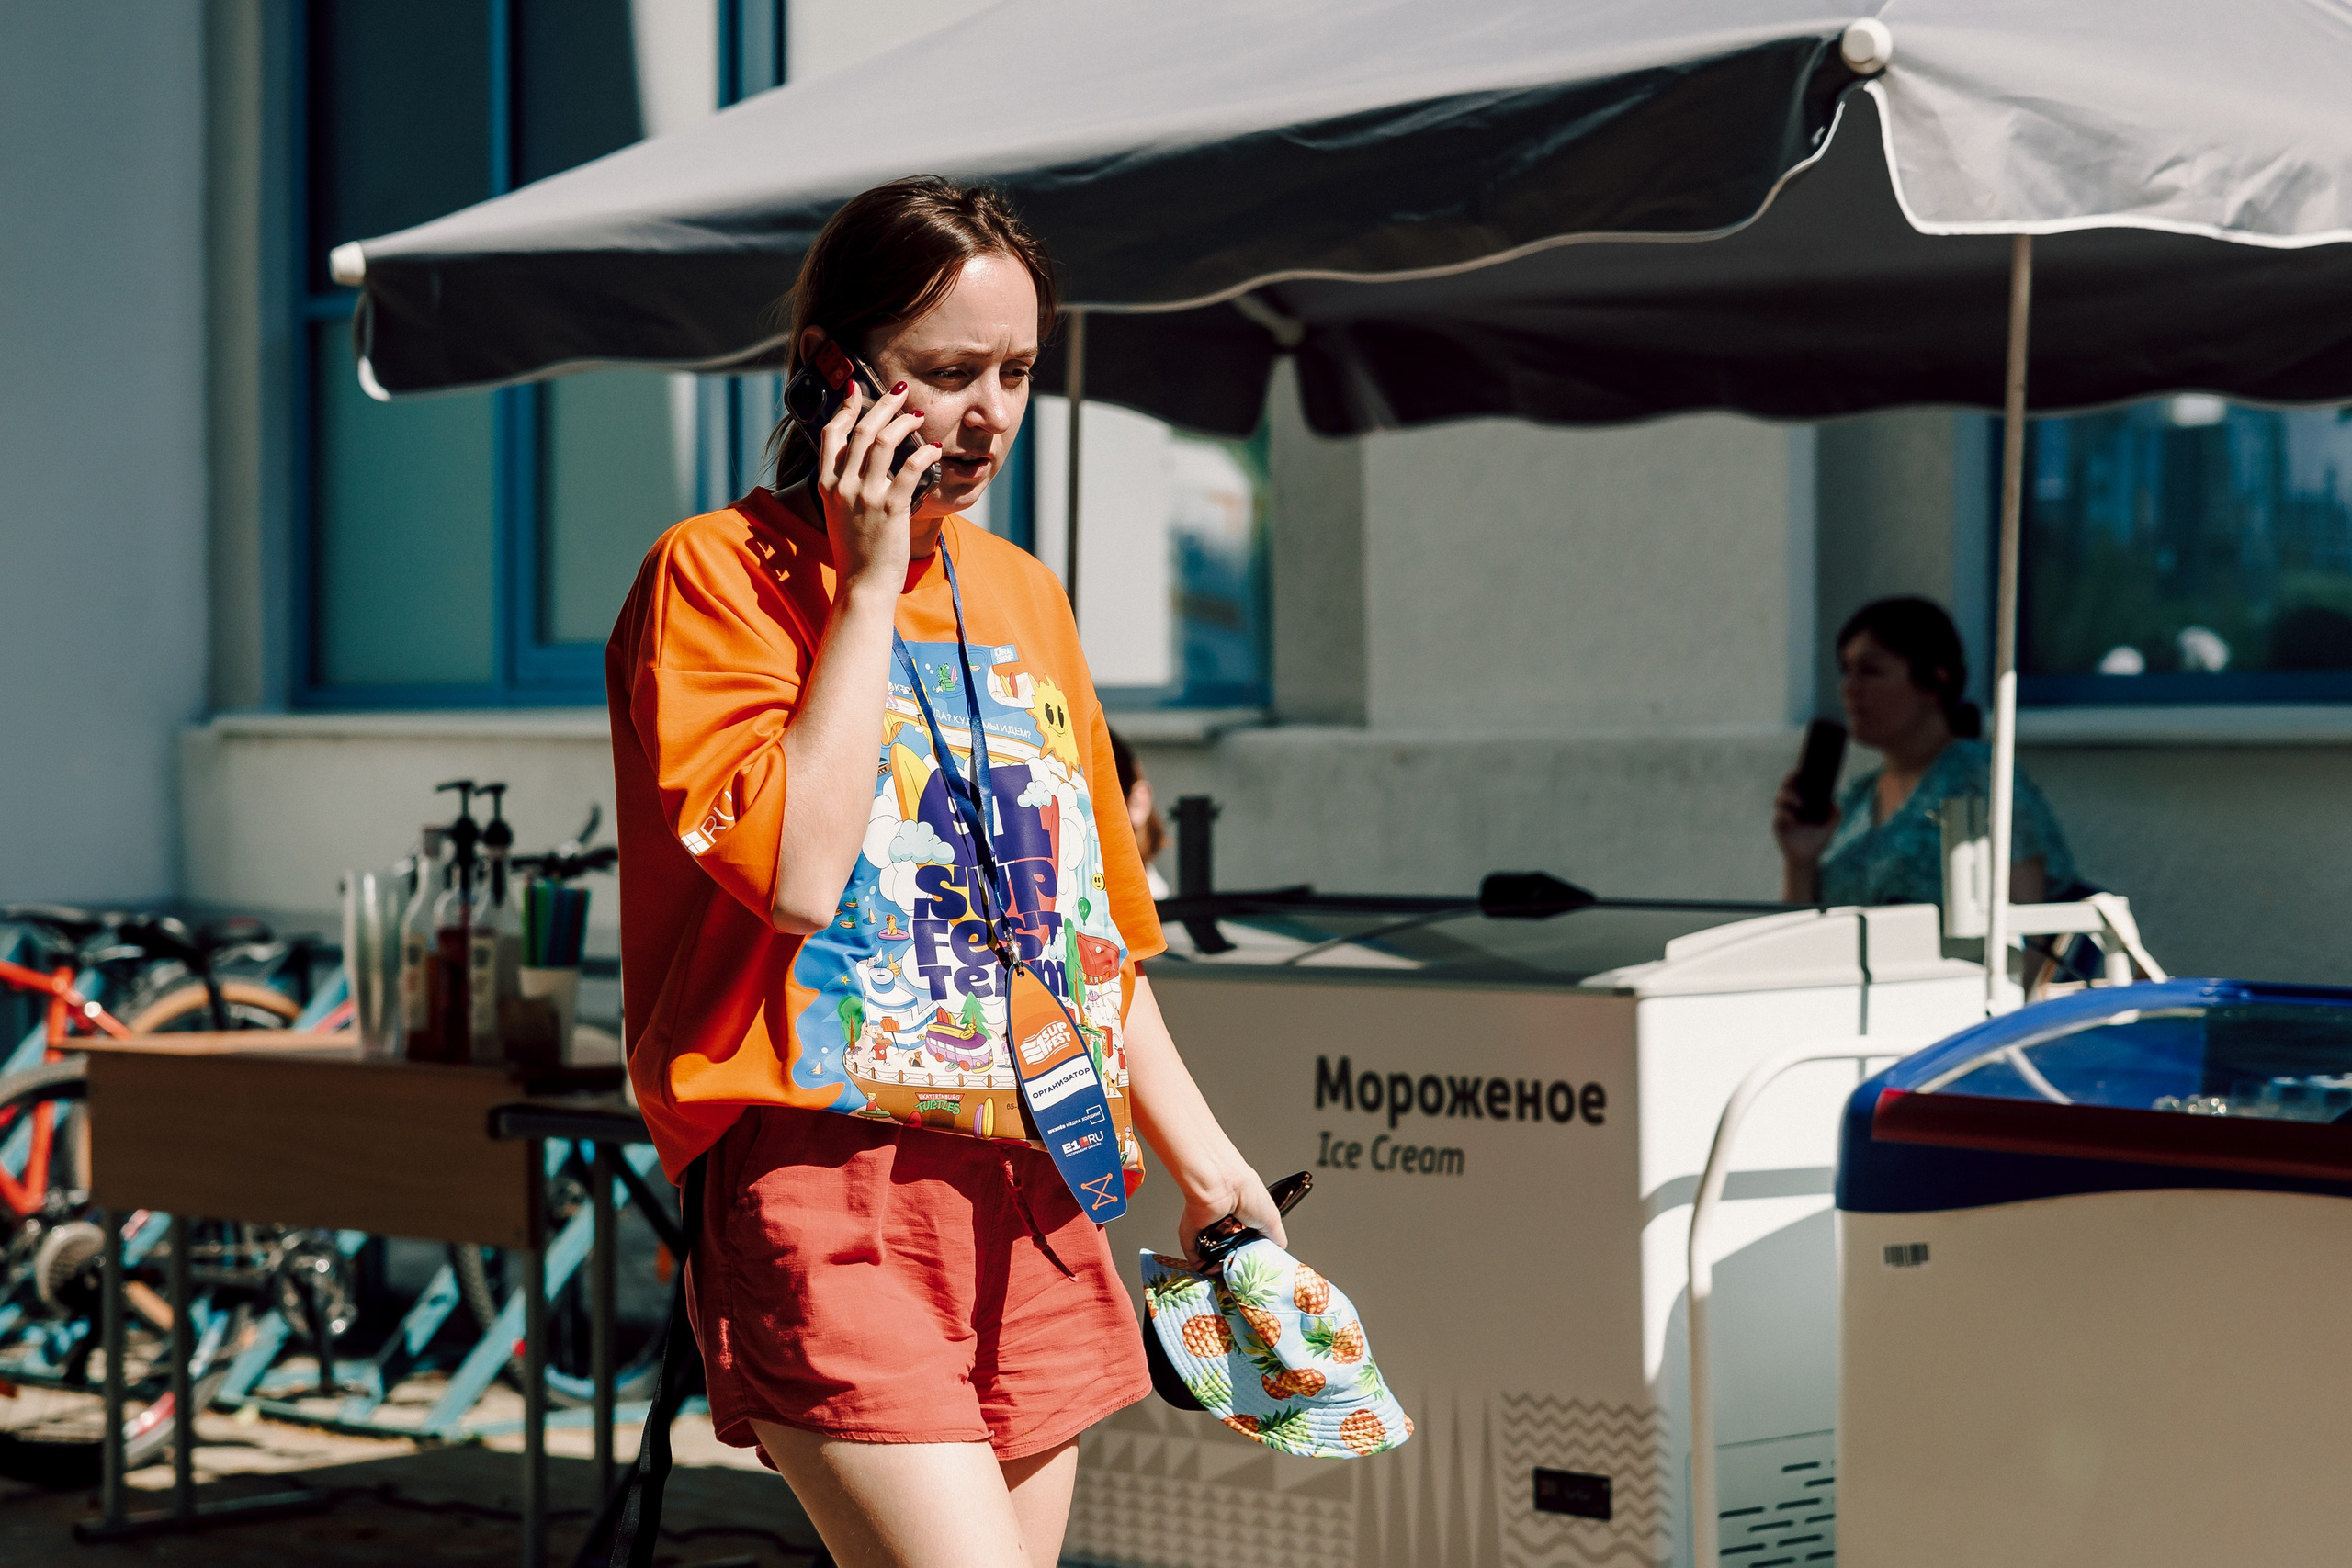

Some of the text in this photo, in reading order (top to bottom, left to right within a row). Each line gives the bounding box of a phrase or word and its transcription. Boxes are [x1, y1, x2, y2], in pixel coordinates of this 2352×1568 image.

[1000, 724, 1032, 739] ИДЕМ?
[913, 859, 1058, 920] SUP
[1041, 1021, 1067, 1042] SUP
[1046, 1032, 1071, 1053] FEST
[1032, 1067, 1091, 1099] ОРГАНИЗАТОР
[1314, 1055, 1608, 1130] Мороженое
[918, 1093, 961, 1101] EKATERINBURG
[914, 1100, 962, 1116] TURTLES
[1317, 1131, 1466, 1176] Ice Cream
